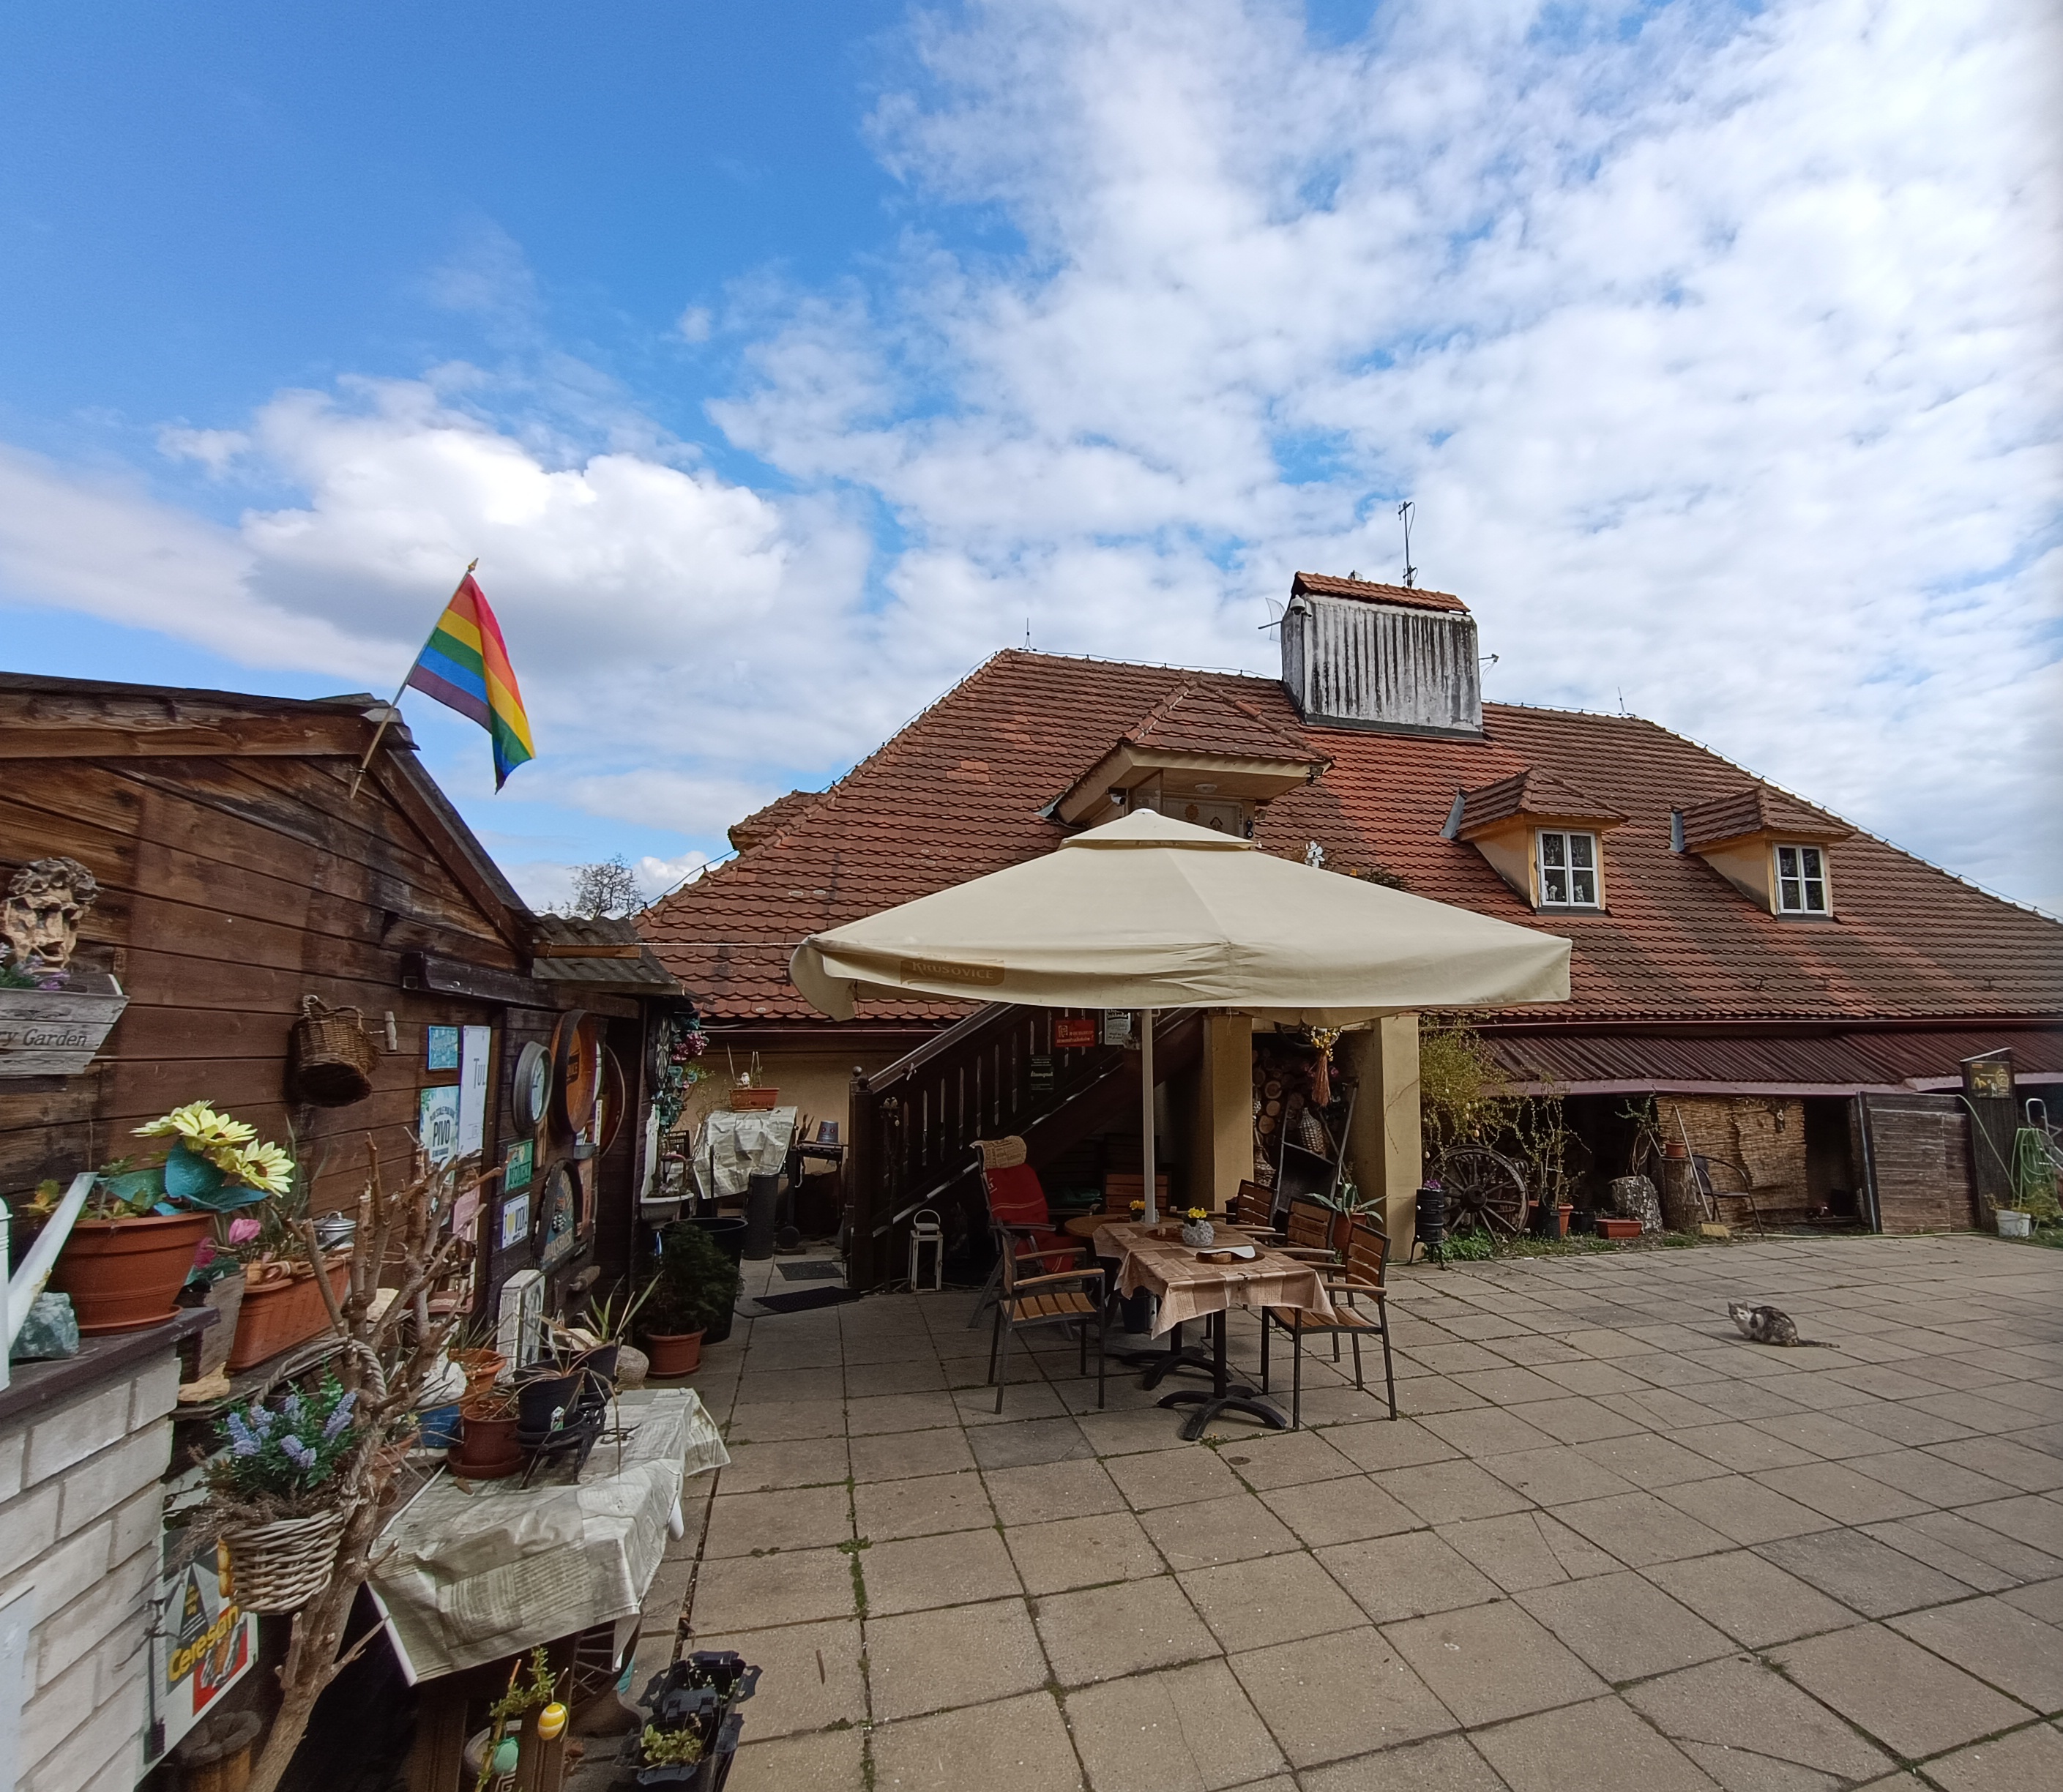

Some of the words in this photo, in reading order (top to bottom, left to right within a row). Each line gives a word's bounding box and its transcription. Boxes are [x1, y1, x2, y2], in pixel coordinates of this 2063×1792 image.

[23, 1028, 87, 1047] Garden
[433, 1119, 451, 1148] PIVO
[168, 1605, 239, 1681] Ceresan
